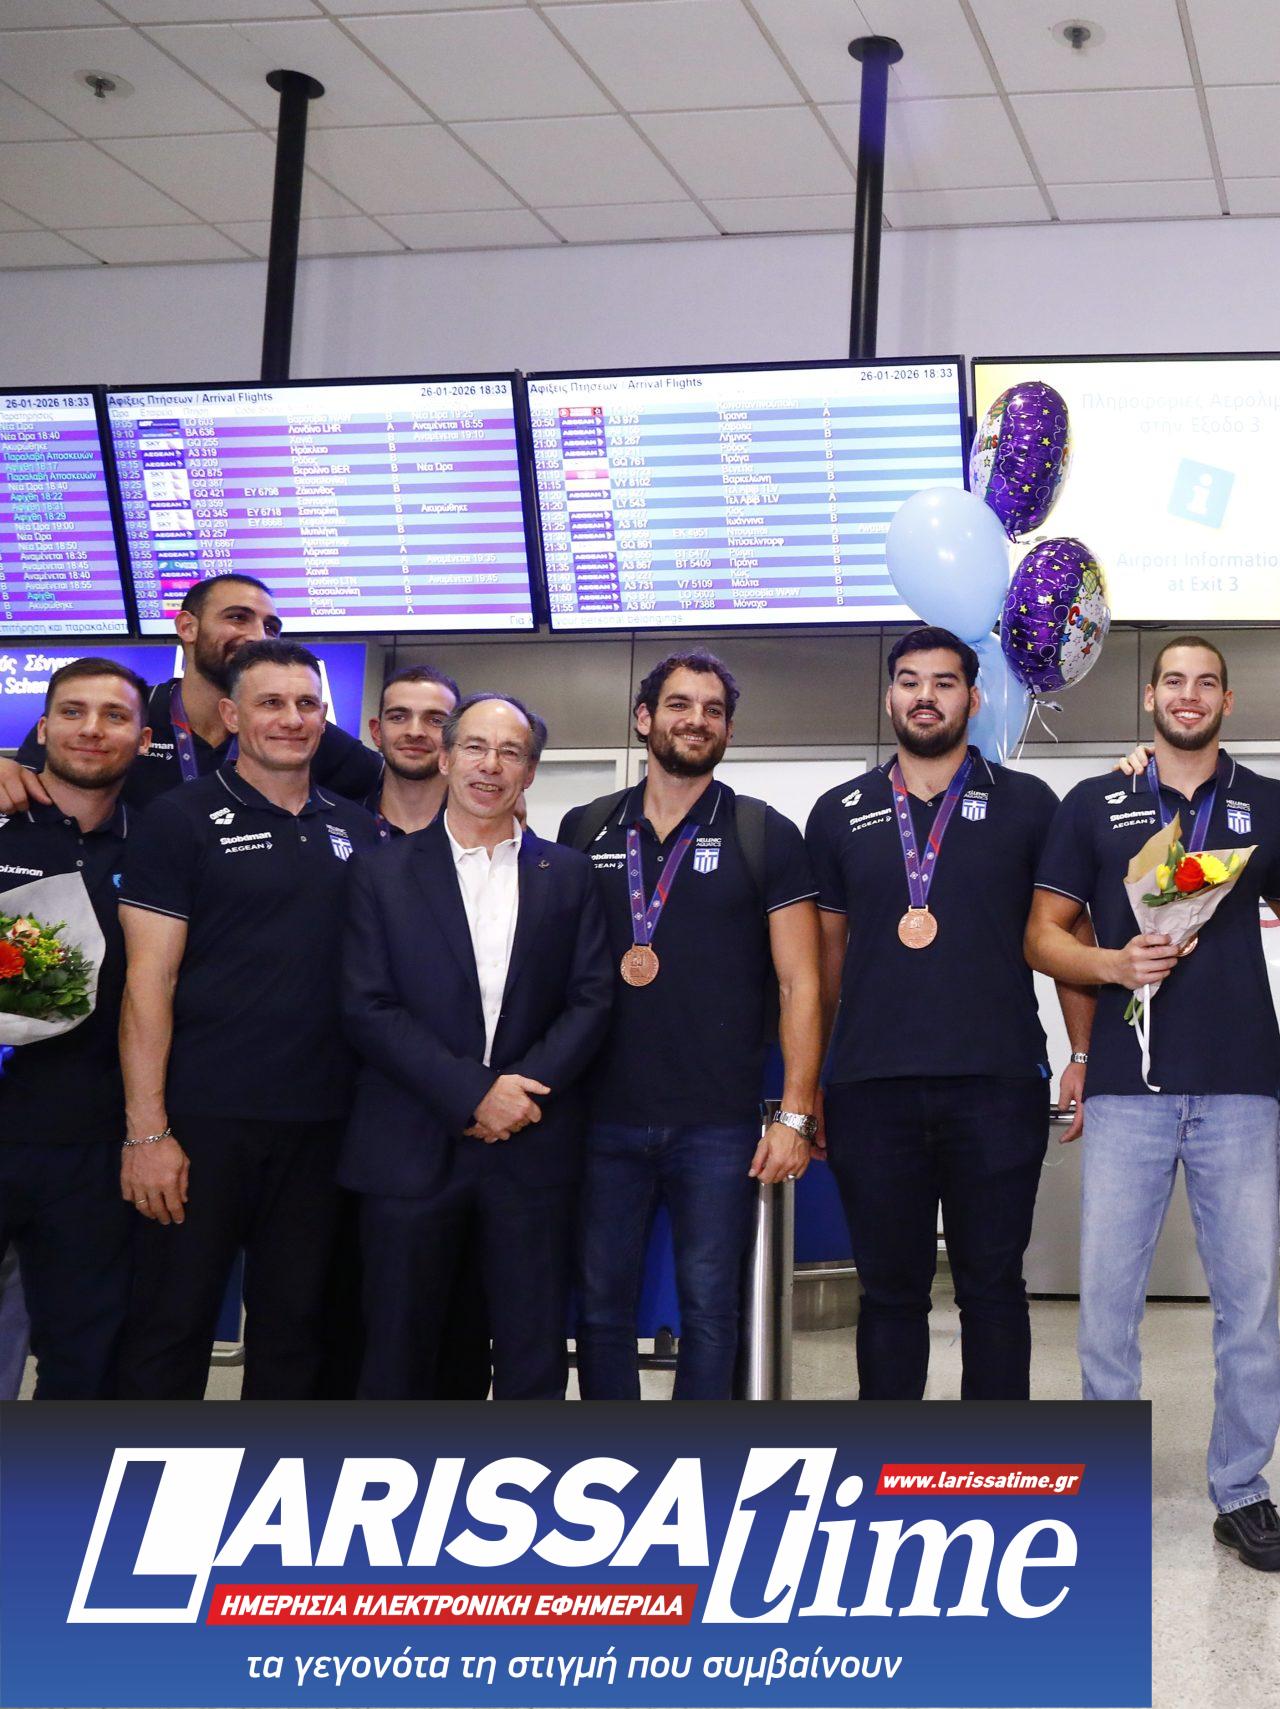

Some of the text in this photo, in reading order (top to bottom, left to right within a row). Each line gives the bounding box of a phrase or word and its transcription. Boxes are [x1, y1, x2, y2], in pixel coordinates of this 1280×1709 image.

[861, 368, 953, 381] 26-01-2026 18:33
[628, 379, 663, 390] Arrival
[666, 378, 702, 388] Flights
[421, 384, 507, 397] 26-01-2026 18:33
[202, 393, 236, 402] Arrival
[238, 392, 272, 402] Flights
[6, 397, 90, 408] 26-01-2026 18:33
[460, 420, 484, 429] 18:55
[1251, 416, 1260, 432] 3
[38, 432, 60, 440] 18:40
[185, 428, 215, 437] BA 636
[188, 449, 217, 458] A3 319
[207, 469, 222, 477] 875
[210, 490, 224, 498] 421
[45, 512, 66, 520] 18:29
[196, 509, 228, 518] GQ 345
[52, 522, 74, 530] 19:00
[200, 530, 227, 538] A3 257
[66, 552, 87, 560] 18:35
[202, 550, 230, 558] A3 913
[676, 559, 712, 568] BT 5409
[1117, 552, 1178, 572] Airport
[68, 571, 90, 580] 18:40
[692, 580, 713, 588] 5109
[1168, 576, 1239, 592] at Exit 3
[626, 602, 638, 610] A3
[694, 600, 716, 609] 7388
[582, 615, 624, 626] personal
[628, 614, 683, 624] belongings
[48, 624, 62, 632] και
[852, 818, 884, 832] AEGEAN
[1112, 818, 1148, 830] AEGEAN
[225, 843, 264, 854] AEGEAN
